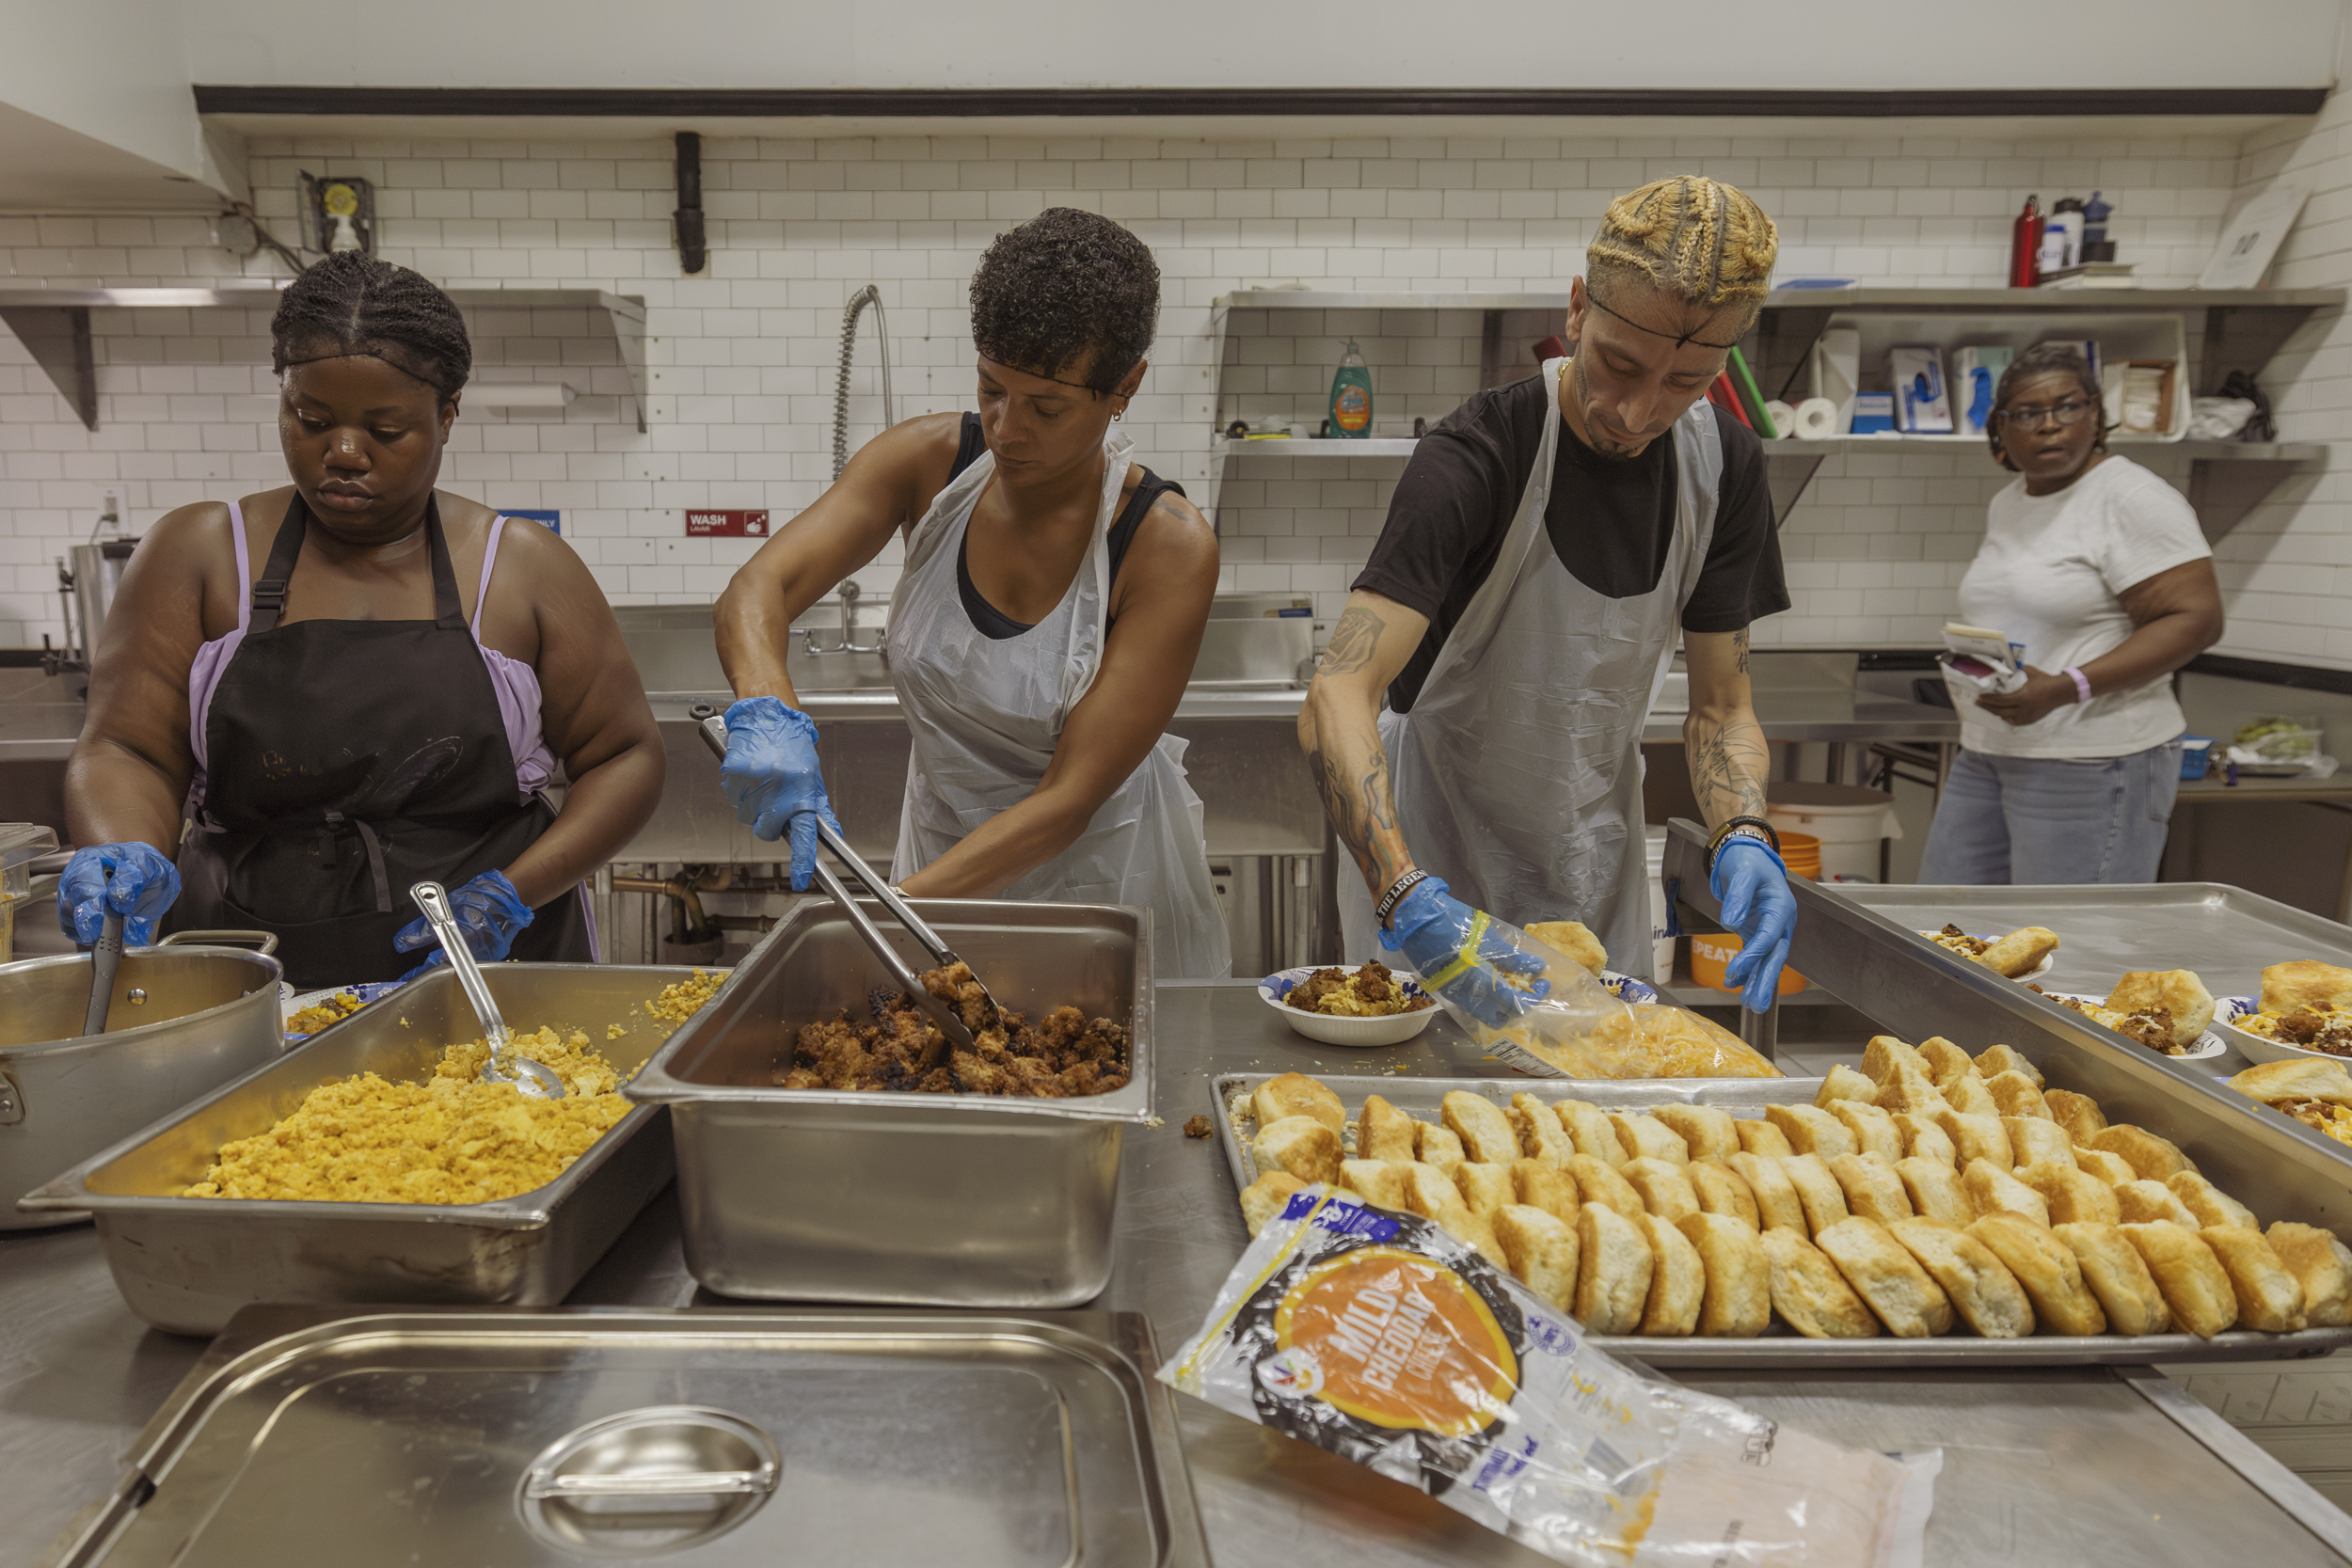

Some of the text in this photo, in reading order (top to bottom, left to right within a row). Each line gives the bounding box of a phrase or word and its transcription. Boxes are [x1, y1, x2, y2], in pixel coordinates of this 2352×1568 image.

[690, 515, 727, 526] WASH
[1377, 894, 1394, 916] THE
[1327, 1288, 1398, 1364] MILD
[1360, 1291, 1433, 1390] CHEDDAR
[1405, 1328, 1452, 1381] CHEESE
